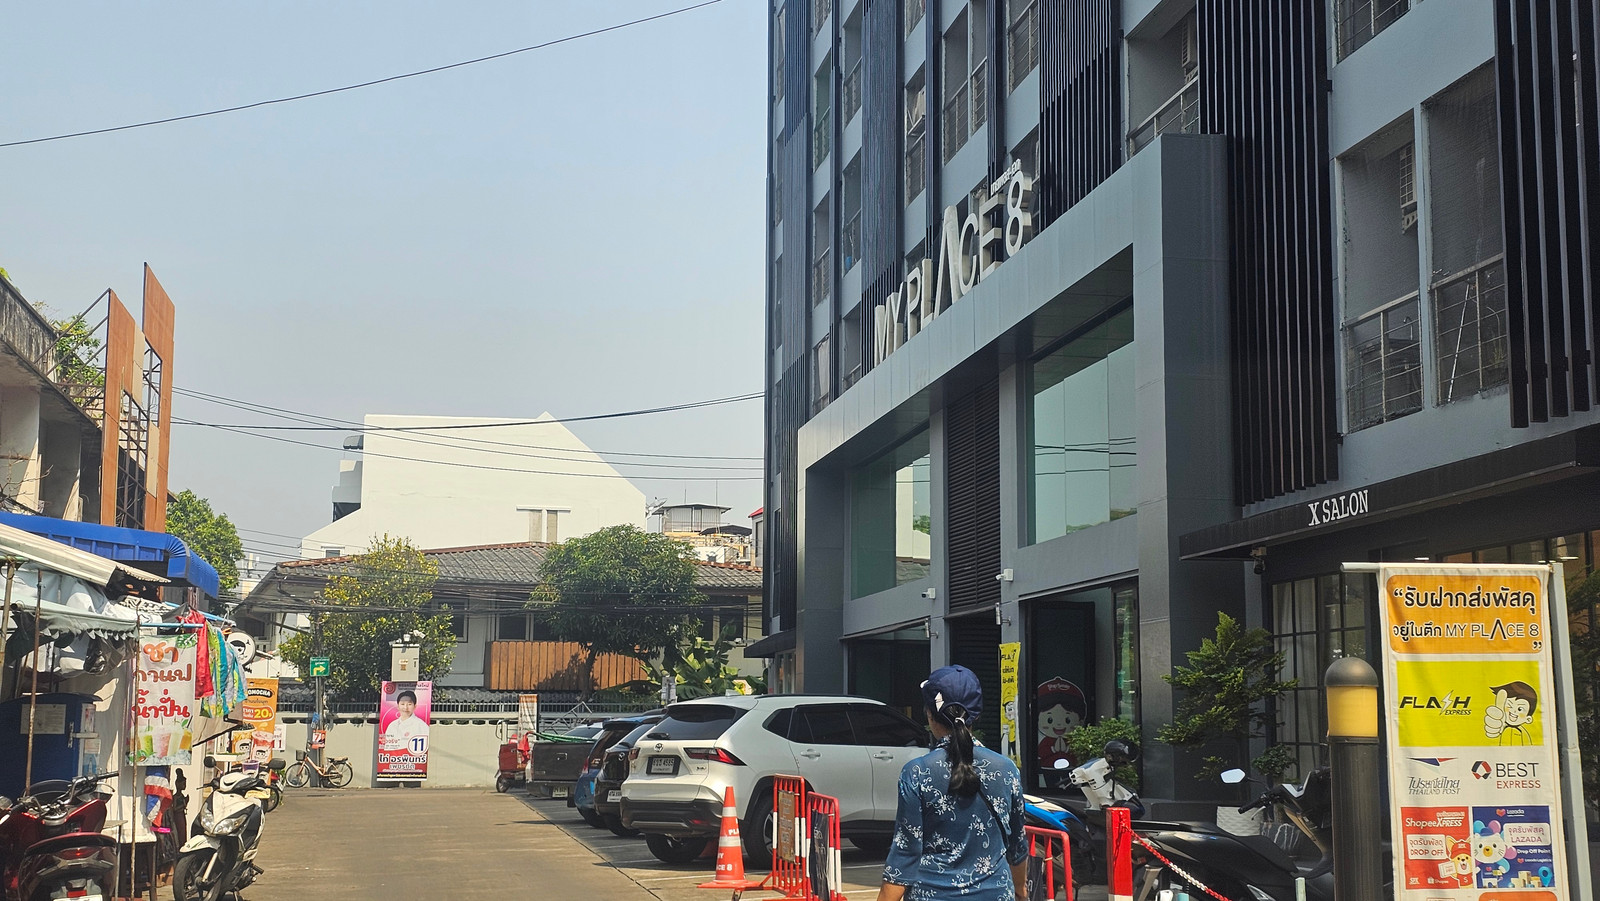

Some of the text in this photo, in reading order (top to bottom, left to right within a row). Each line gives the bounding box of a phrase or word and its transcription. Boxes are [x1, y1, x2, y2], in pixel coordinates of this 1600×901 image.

[874, 281, 907, 369] MY
[1005, 170, 1030, 258] 8
[1308, 490, 1369, 526] X SALON
[1393, 620, 1539, 641] อยู่ในตึก MY PLACE 8
[143, 641, 179, 662] ชา
[1399, 693, 1471, 711] FLASH
[411, 737, 425, 752] 11
[1496, 762, 1540, 778] BEST
[1408, 787, 1461, 795] THAILAND POST
[1496, 780, 1541, 789] EXPRESS
[726, 863, 733, 871] 8
